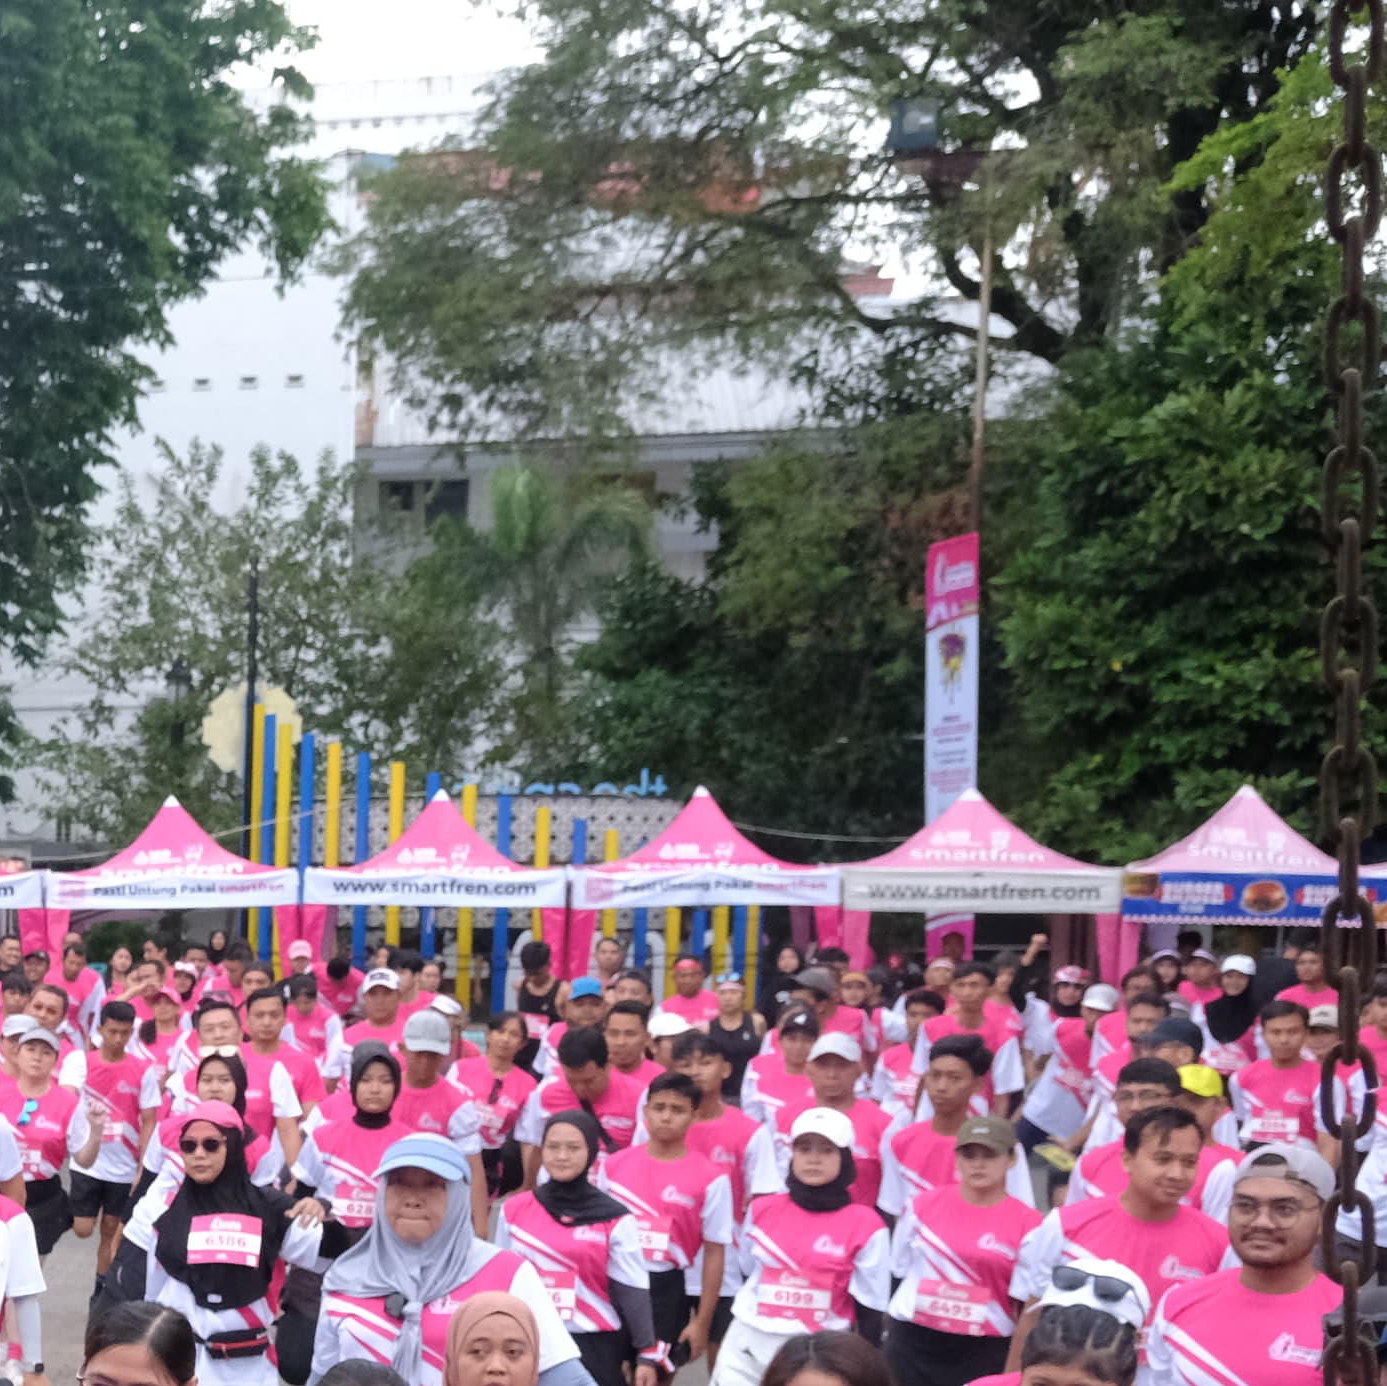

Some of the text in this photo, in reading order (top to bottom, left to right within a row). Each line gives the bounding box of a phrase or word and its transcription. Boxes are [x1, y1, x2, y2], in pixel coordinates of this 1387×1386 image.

[909, 847, 1046, 863] smartfren
[333, 879, 536, 895] www.smartfren.com
[868, 884, 1100, 900] www.smartfren.com
[774, 1290, 815, 1304] 6199
